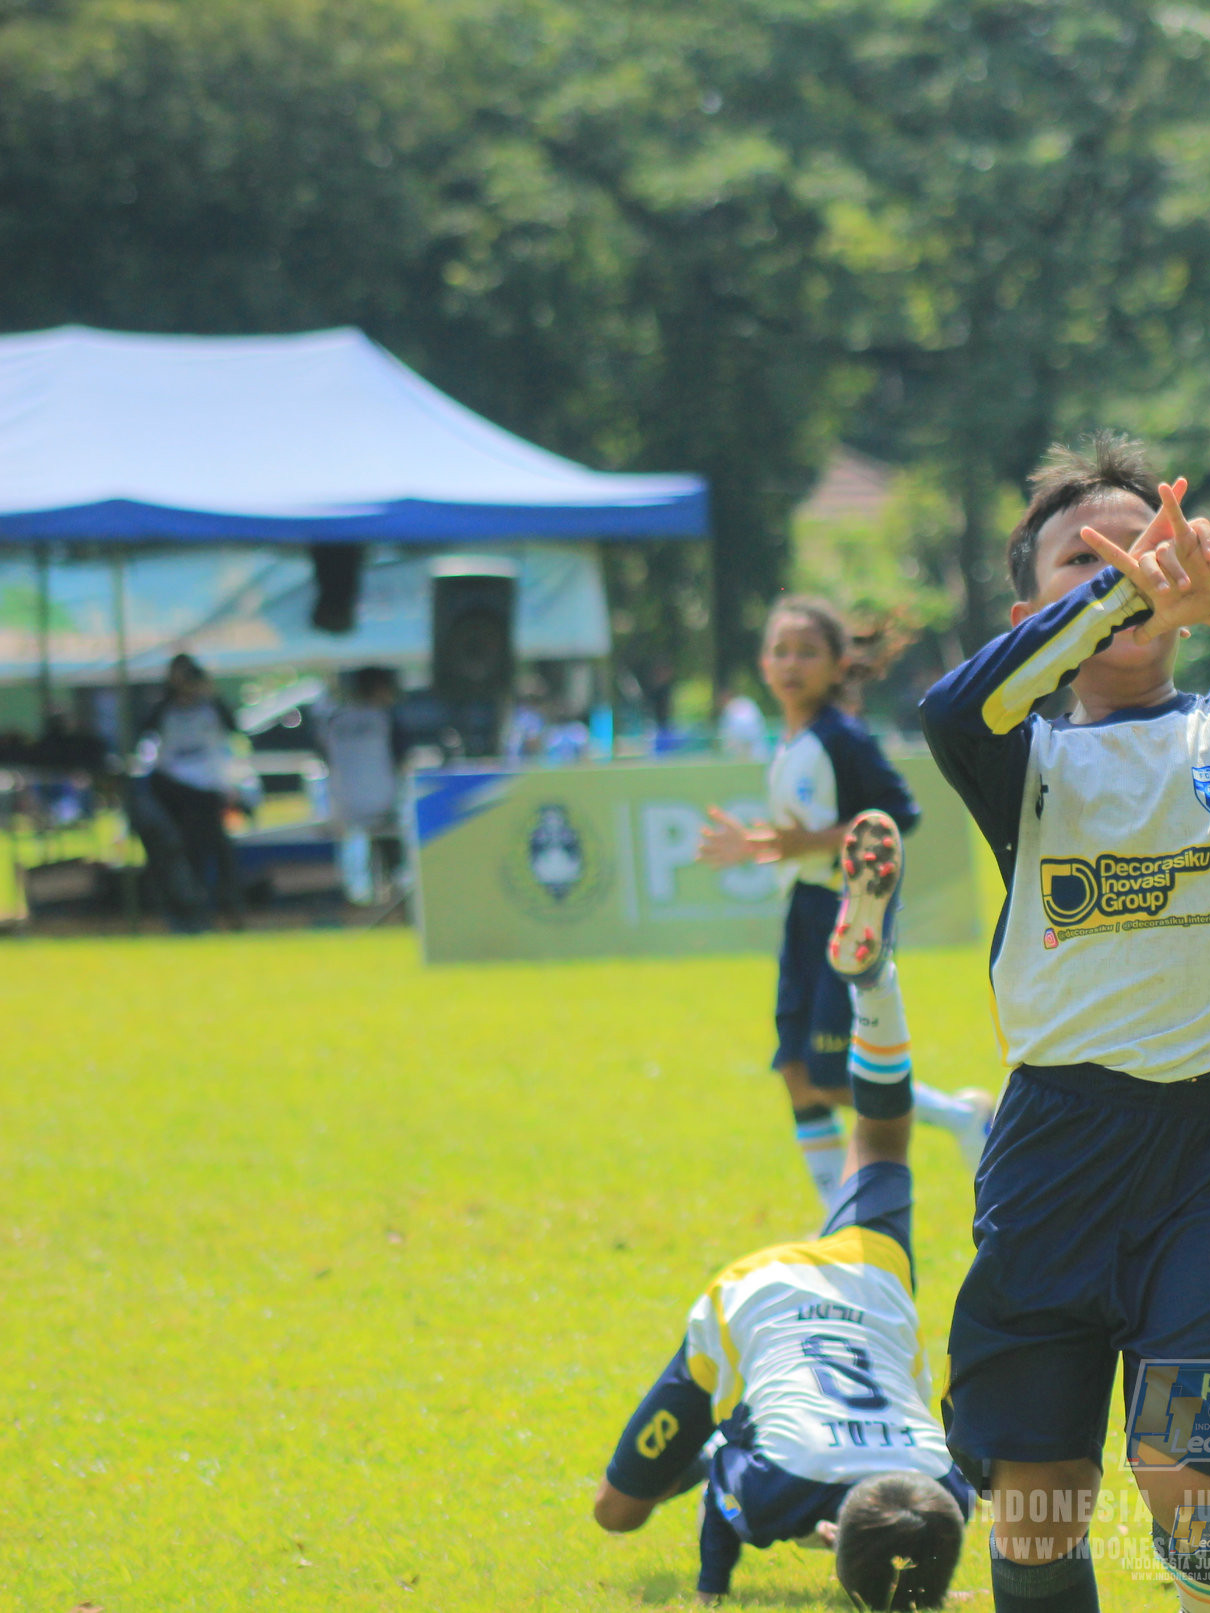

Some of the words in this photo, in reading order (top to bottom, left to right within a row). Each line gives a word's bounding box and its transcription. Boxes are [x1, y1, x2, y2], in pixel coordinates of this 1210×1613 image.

[1101, 851, 1210, 877] Decorasiku
[1102, 869, 1171, 895] Inovasi
[1101, 891, 1164, 912] Group
